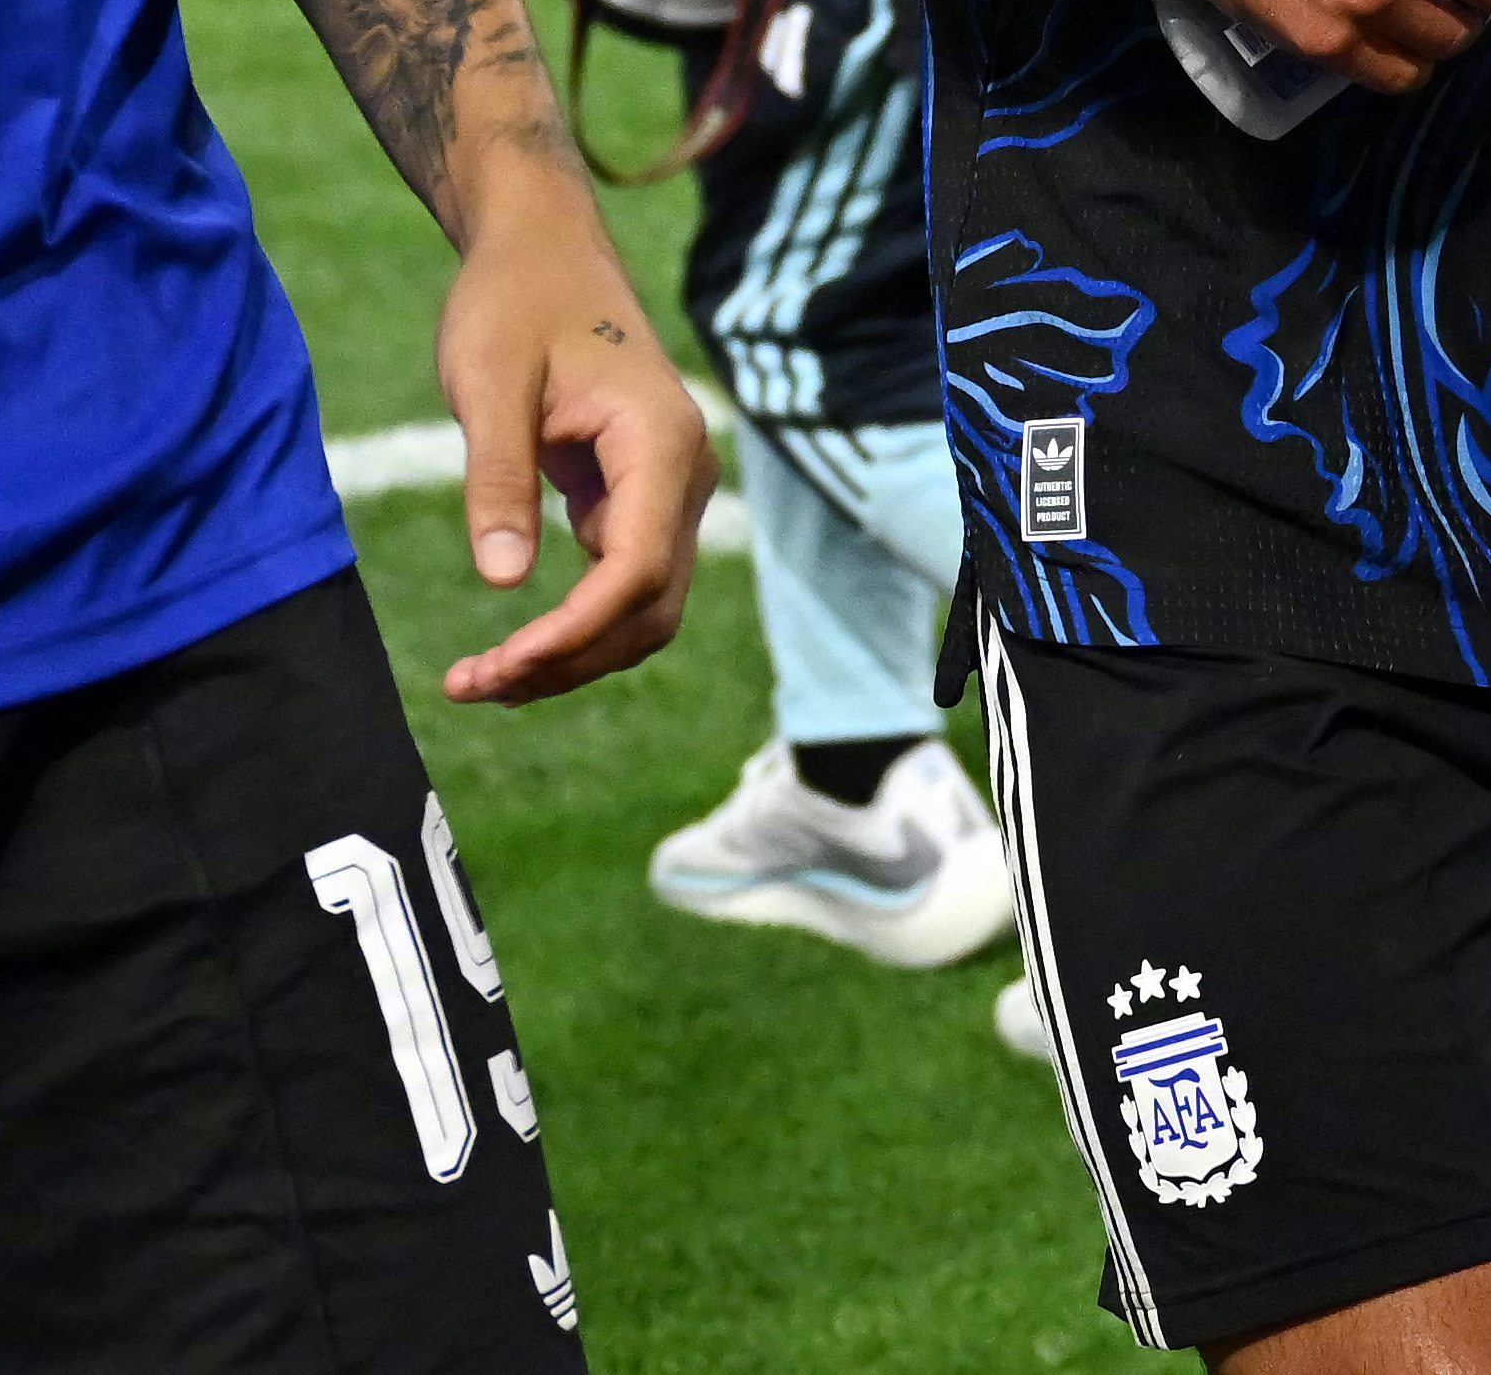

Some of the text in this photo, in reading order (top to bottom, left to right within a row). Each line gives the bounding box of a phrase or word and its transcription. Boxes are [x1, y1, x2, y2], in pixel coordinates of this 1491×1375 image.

[1034, 480, 1073, 493] AUTHENTIC
[1035, 495, 1070, 507] LICENSED
[1036, 510, 1071, 523] PRODUCT
[1147, 1067, 1226, 1150] AFA
